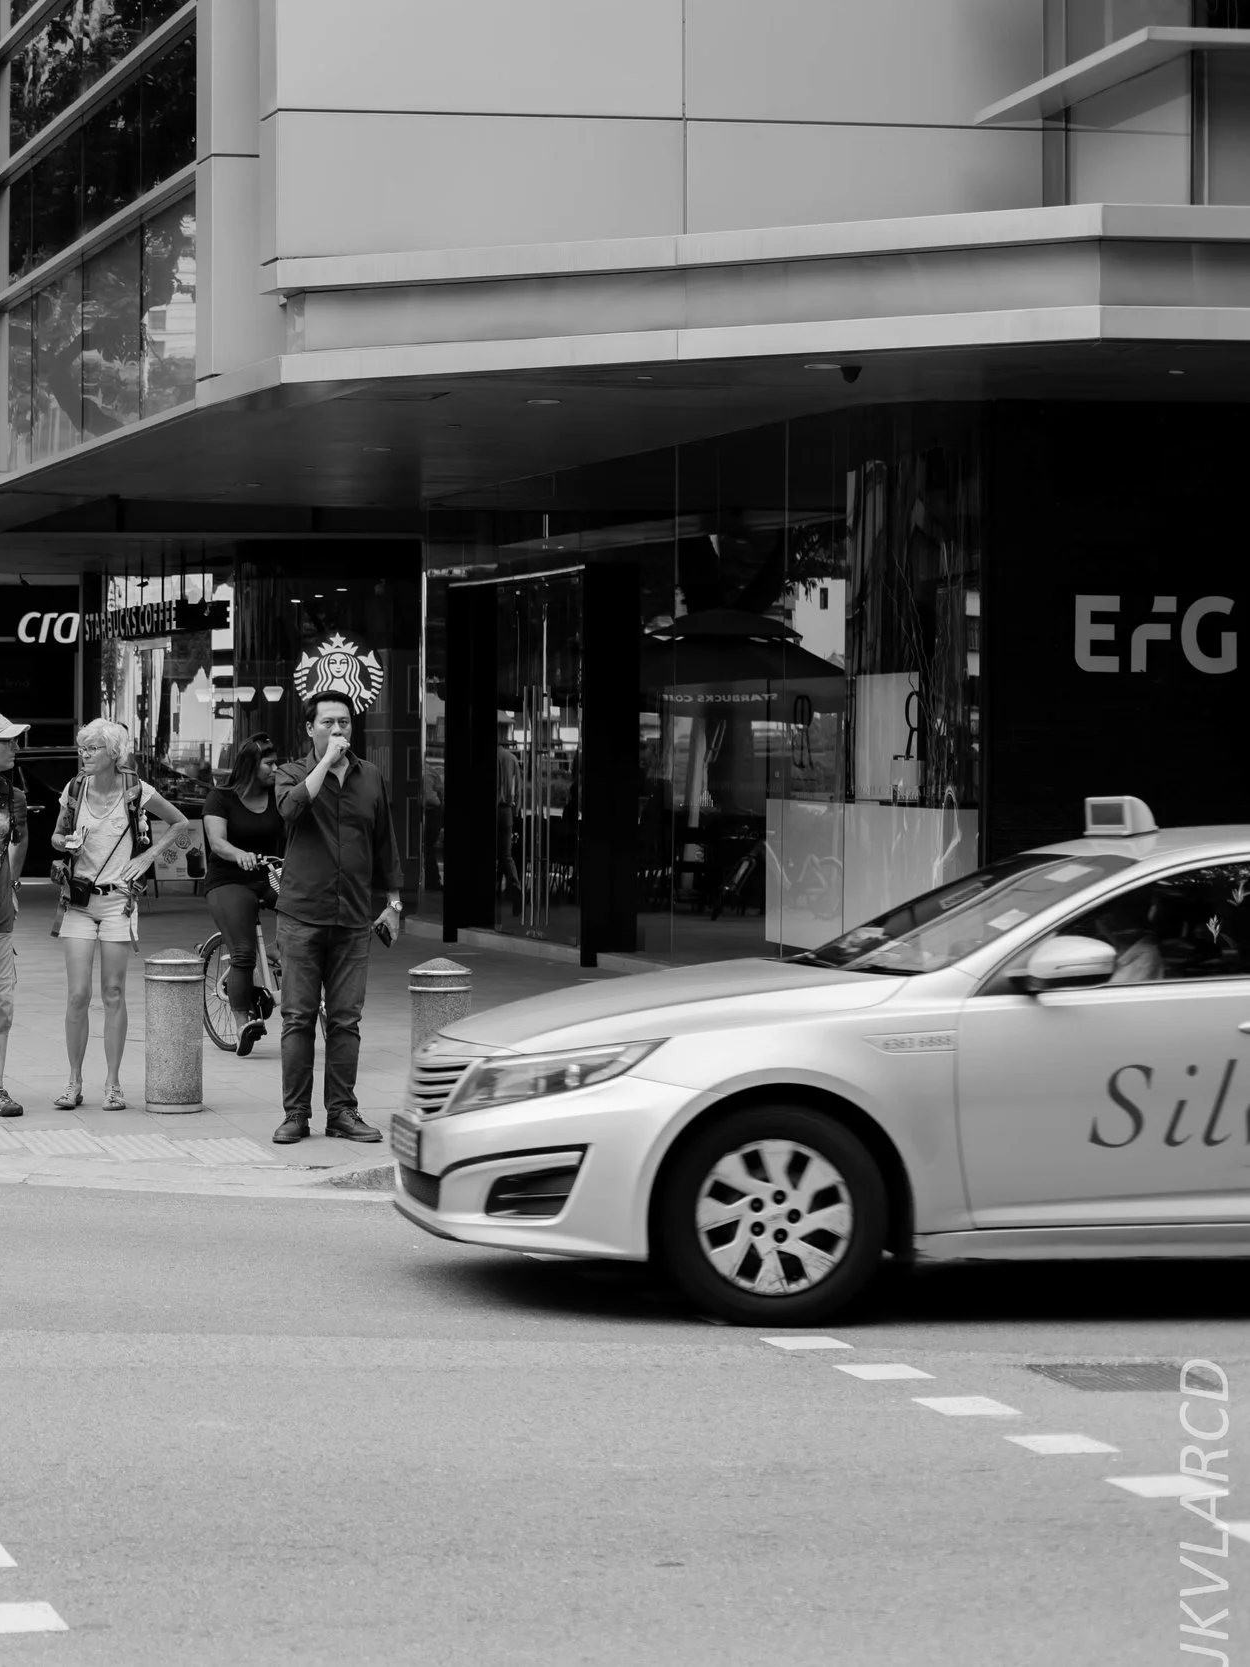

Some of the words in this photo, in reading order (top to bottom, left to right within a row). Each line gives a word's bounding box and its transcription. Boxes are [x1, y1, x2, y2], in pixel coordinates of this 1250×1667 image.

[84, 606, 137, 641] STARBUCKS
[138, 599, 177, 633] COFFEE
[1074, 594, 1238, 675] EFG
[1088, 1059, 1250, 1148] Sil
